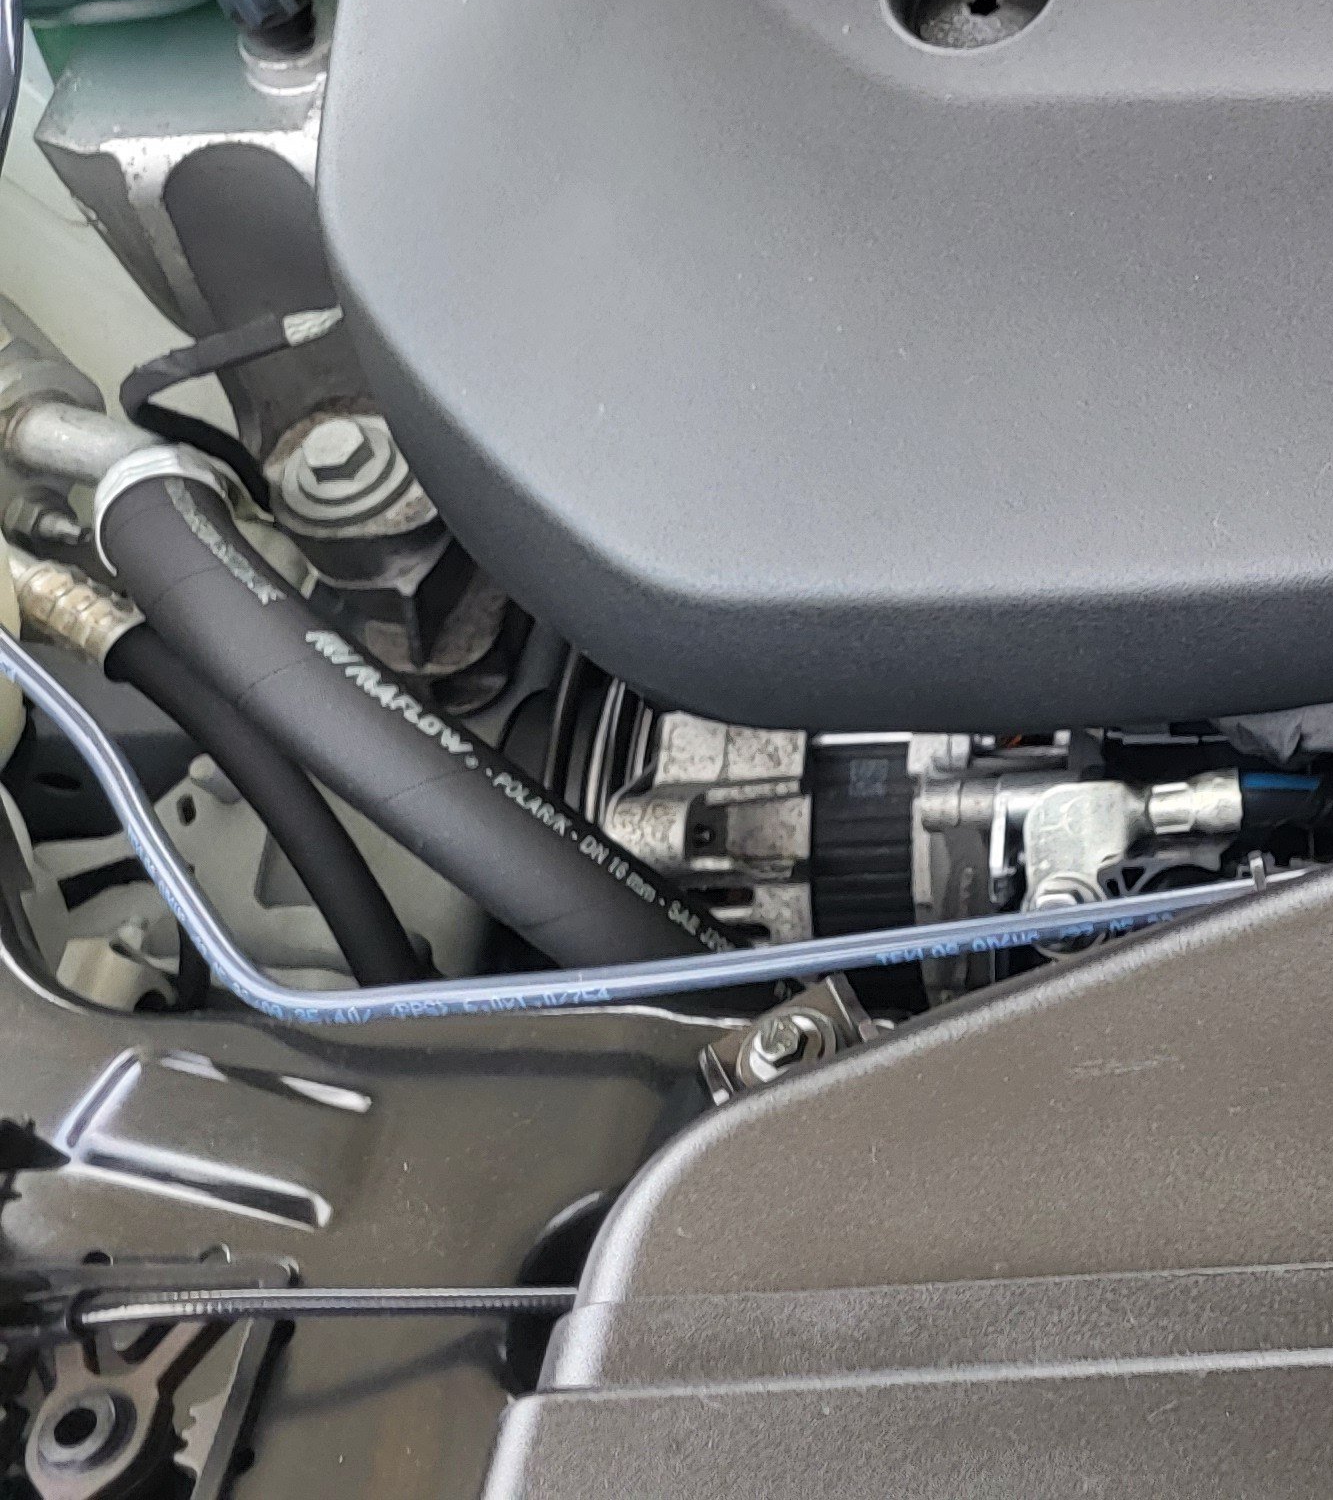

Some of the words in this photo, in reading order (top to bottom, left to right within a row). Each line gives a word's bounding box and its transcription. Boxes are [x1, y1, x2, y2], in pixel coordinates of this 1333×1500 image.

[579, 835, 610, 865] DN
[608, 856, 630, 880] 16
[626, 872, 657, 903] mm
